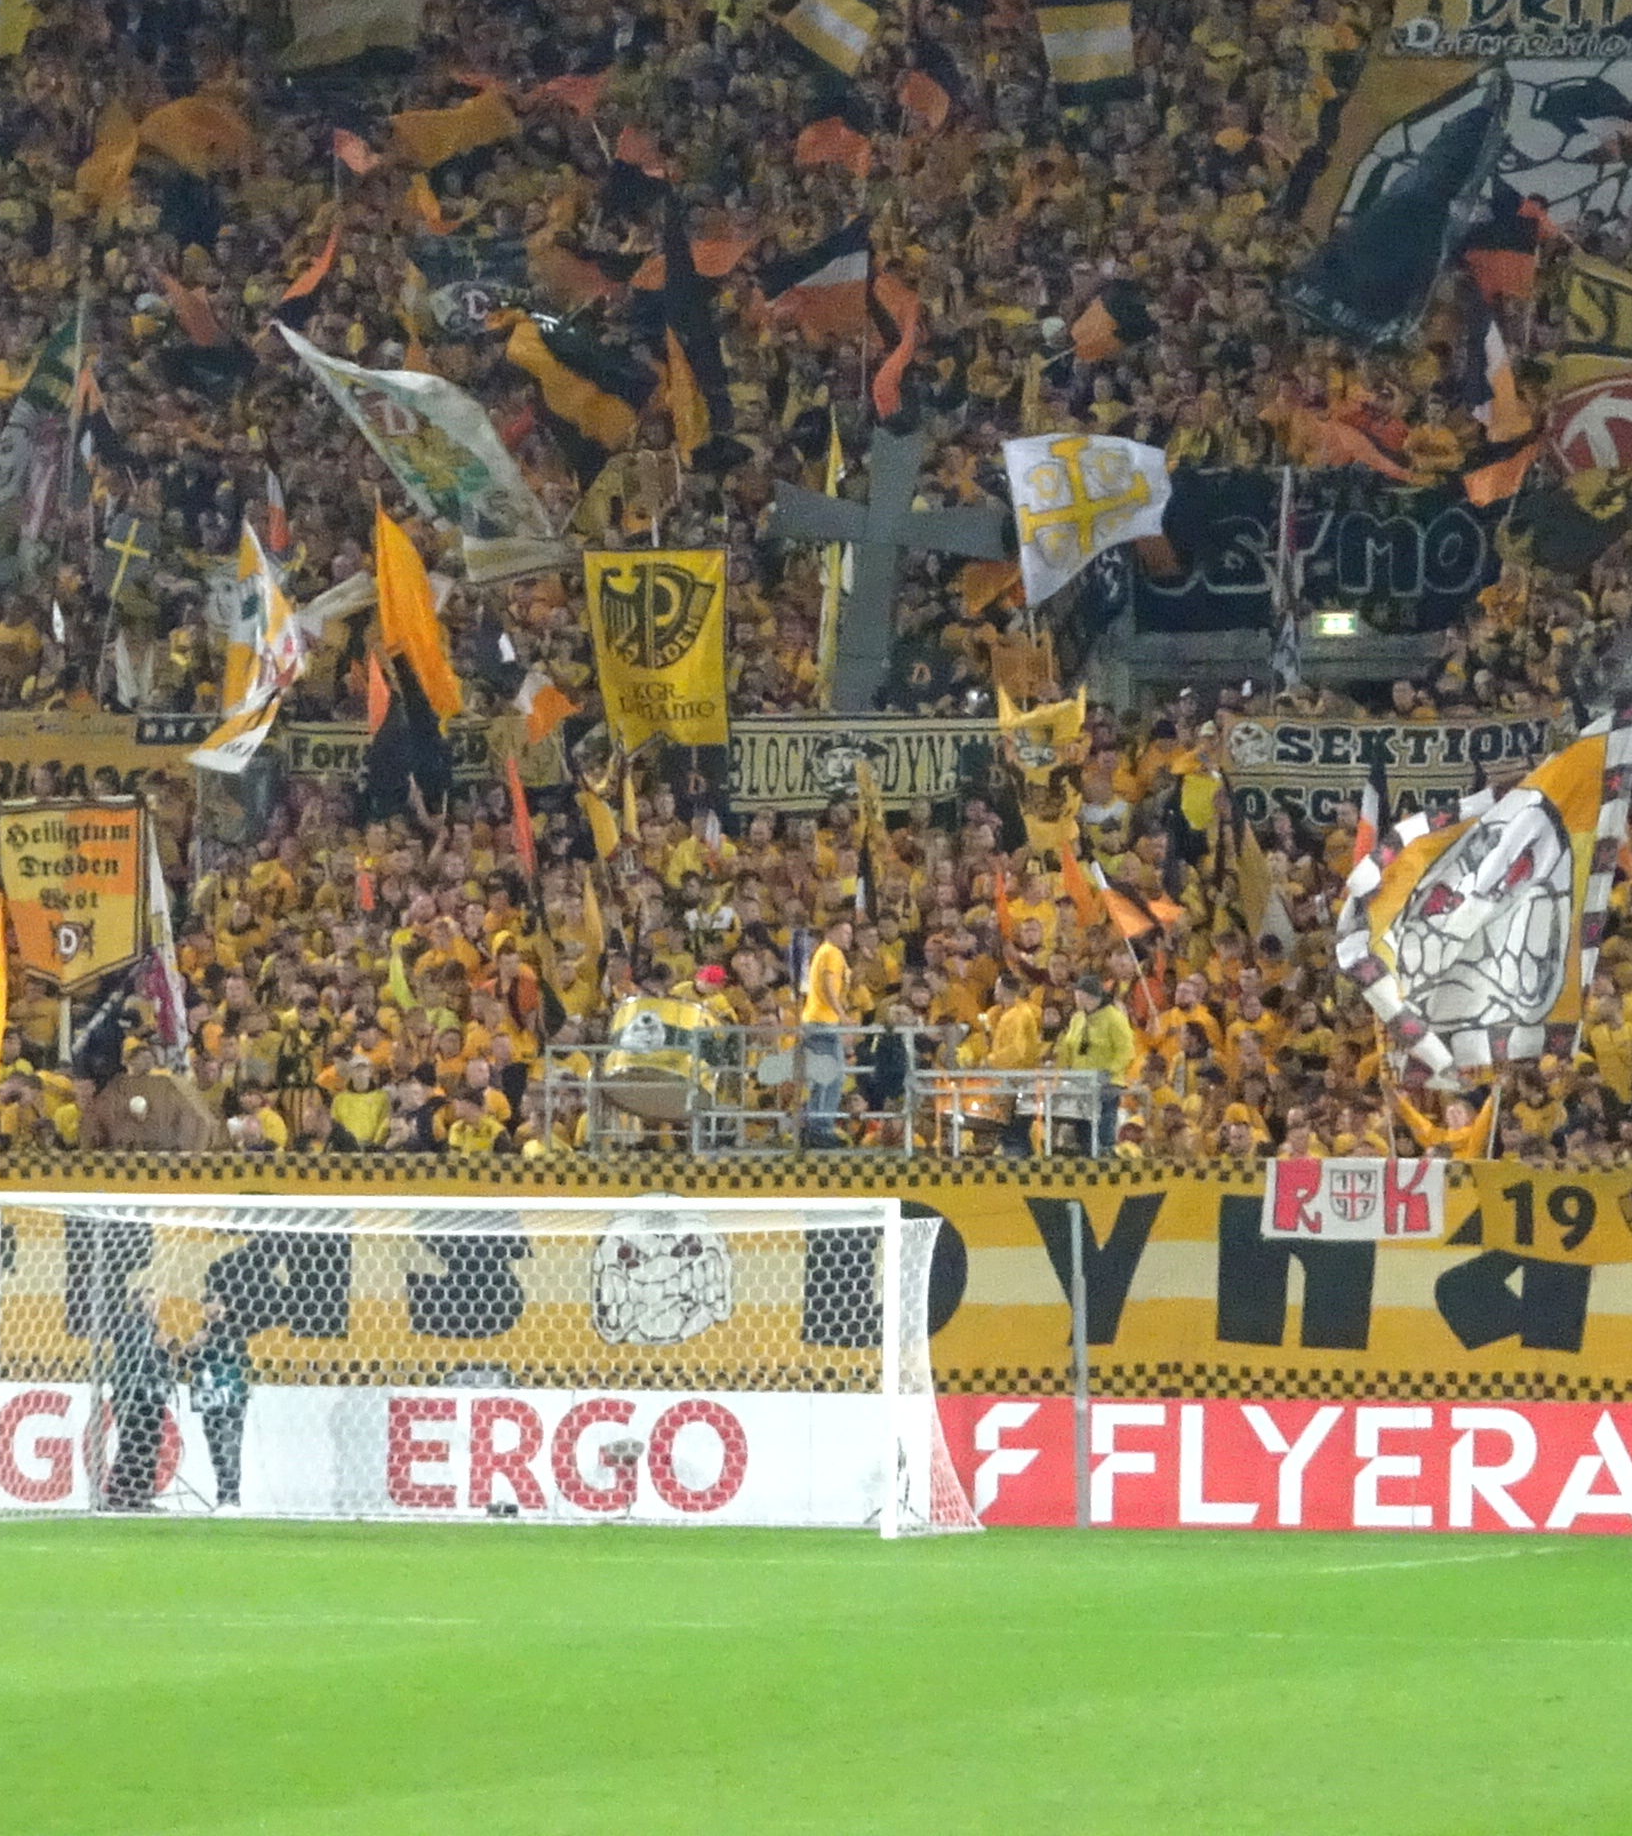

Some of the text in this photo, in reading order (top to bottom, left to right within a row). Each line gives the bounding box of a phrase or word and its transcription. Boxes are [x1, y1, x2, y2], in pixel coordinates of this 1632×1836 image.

[1275, 721, 1554, 766] SEKTION
[1502, 1179, 1595, 1251] 19
[385, 1397, 750, 1514] ERGO
